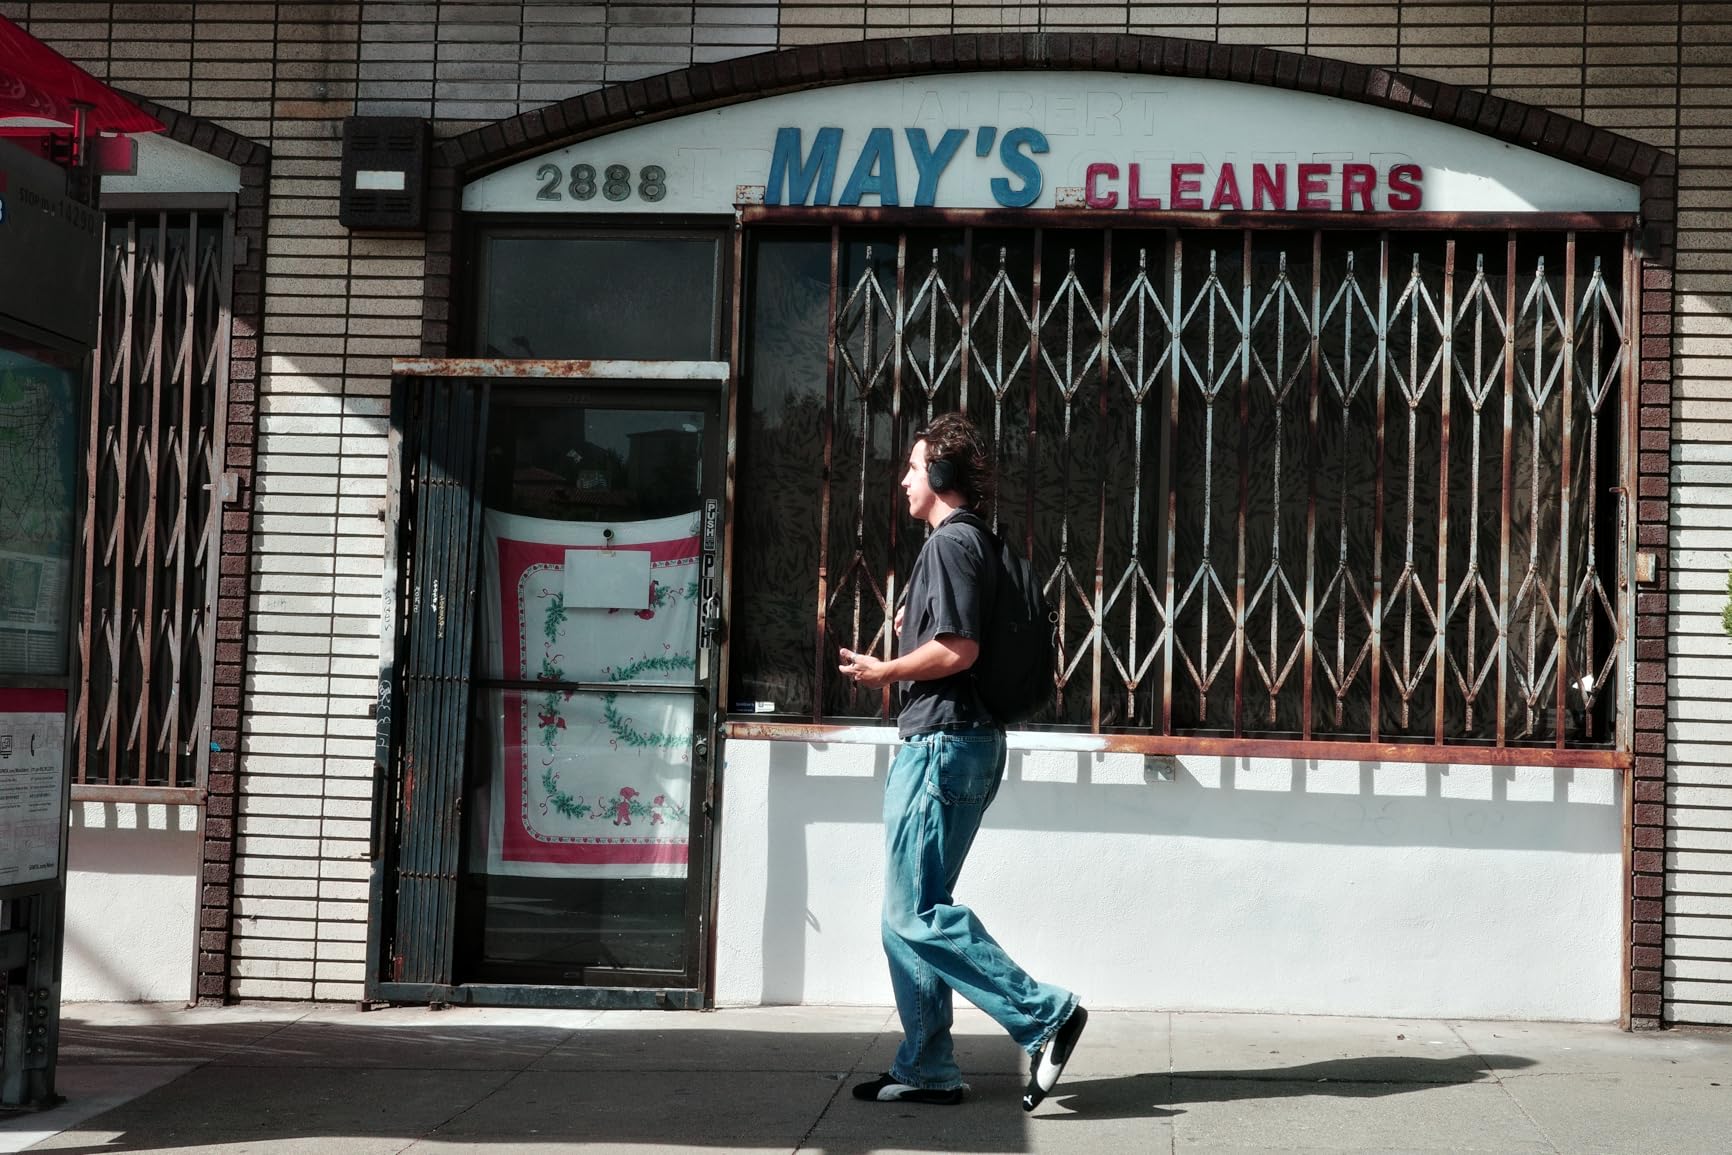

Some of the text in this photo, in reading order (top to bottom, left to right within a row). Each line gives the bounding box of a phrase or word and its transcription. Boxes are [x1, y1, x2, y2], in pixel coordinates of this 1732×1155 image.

[535, 163, 668, 203] 2888
[764, 127, 1050, 209] MAY'S
[1085, 162, 1424, 211] CLEANERS
[706, 503, 716, 538] PUSH
